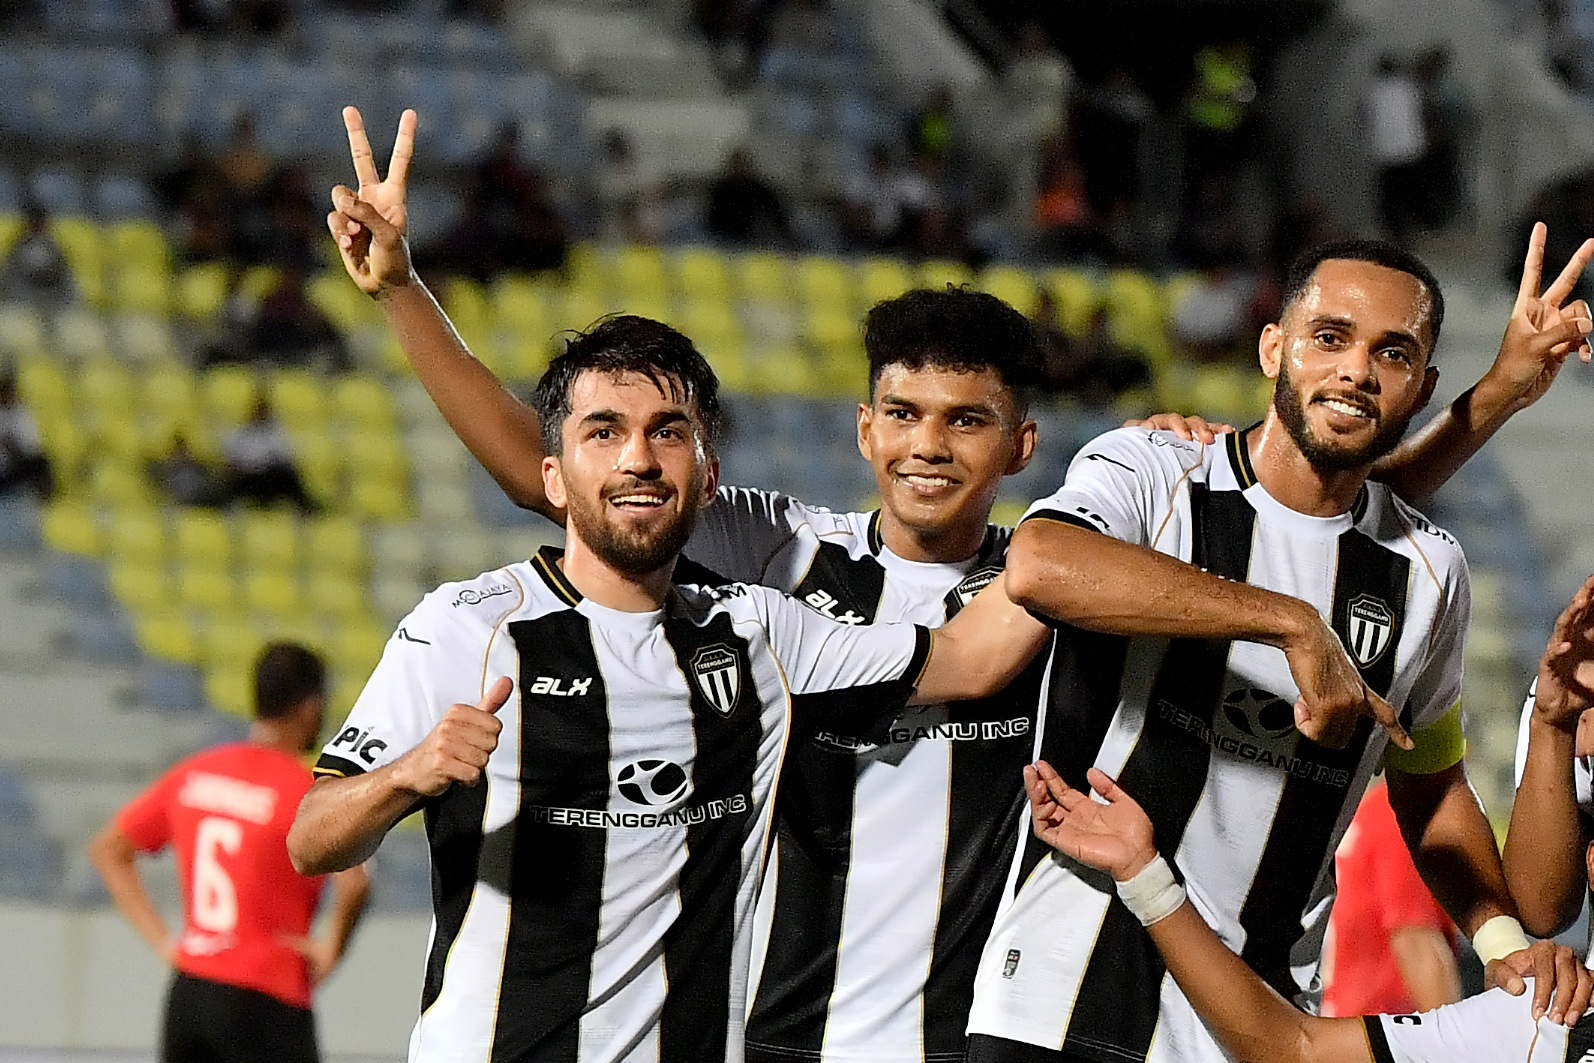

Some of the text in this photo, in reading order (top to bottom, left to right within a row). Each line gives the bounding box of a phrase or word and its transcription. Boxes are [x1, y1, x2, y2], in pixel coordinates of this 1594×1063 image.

[982, 717, 1030, 740] INC
[1313, 764, 1349, 788] INC
[529, 794, 747, 829] TERENGGANU INC
[193, 816, 244, 933] 6
